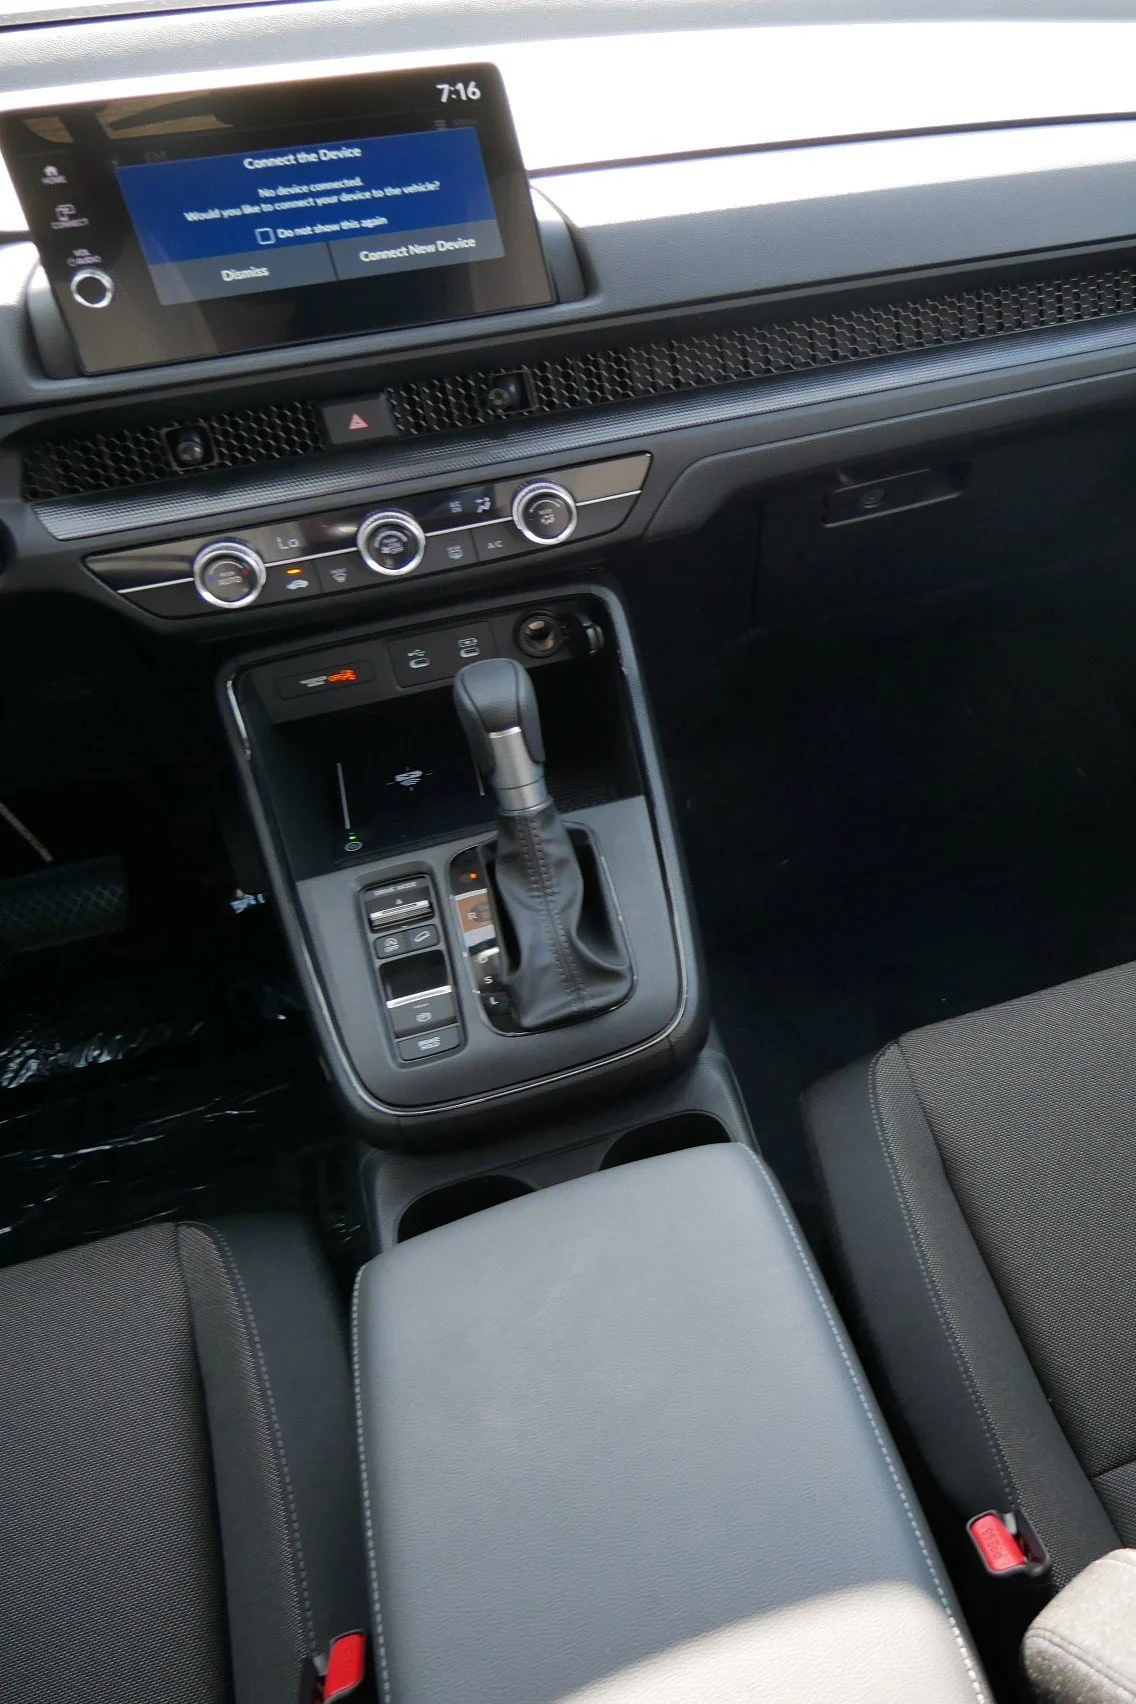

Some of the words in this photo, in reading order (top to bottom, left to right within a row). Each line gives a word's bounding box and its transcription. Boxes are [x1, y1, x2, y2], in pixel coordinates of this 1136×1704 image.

[435, 81, 481, 103] 7:16
[243, 154, 296, 169] Connect
[296, 151, 319, 164] the
[318, 147, 362, 161] Device
[257, 187, 276, 198] No
[276, 184, 309, 196] device
[309, 176, 364, 192] connected.
[183, 207, 221, 222] Would
[220, 207, 242, 219] you
[241, 203, 261, 215] like
[260, 203, 274, 212] to
[274, 197, 315, 211] connect
[314, 195, 338, 207] your
[339, 190, 372, 202] device
[371, 189, 384, 198] to
[383, 185, 402, 196] the
[401, 180, 441, 195] vehicle?
[276, 228, 295, 238] Do
[294, 225, 313, 236] not
[313, 223, 340, 234] show
[339, 219, 361, 230] this
[360, 215, 388, 229] again
[359, 246, 409, 262] Connect
[408, 243, 437, 255] New
[436, 237, 476, 252] Device
[221, 266, 270, 281] Dismiss
[275, 536, 300, 550] Lo
[483, 975, 494, 985] S
[489, 996, 499, 1005] L
